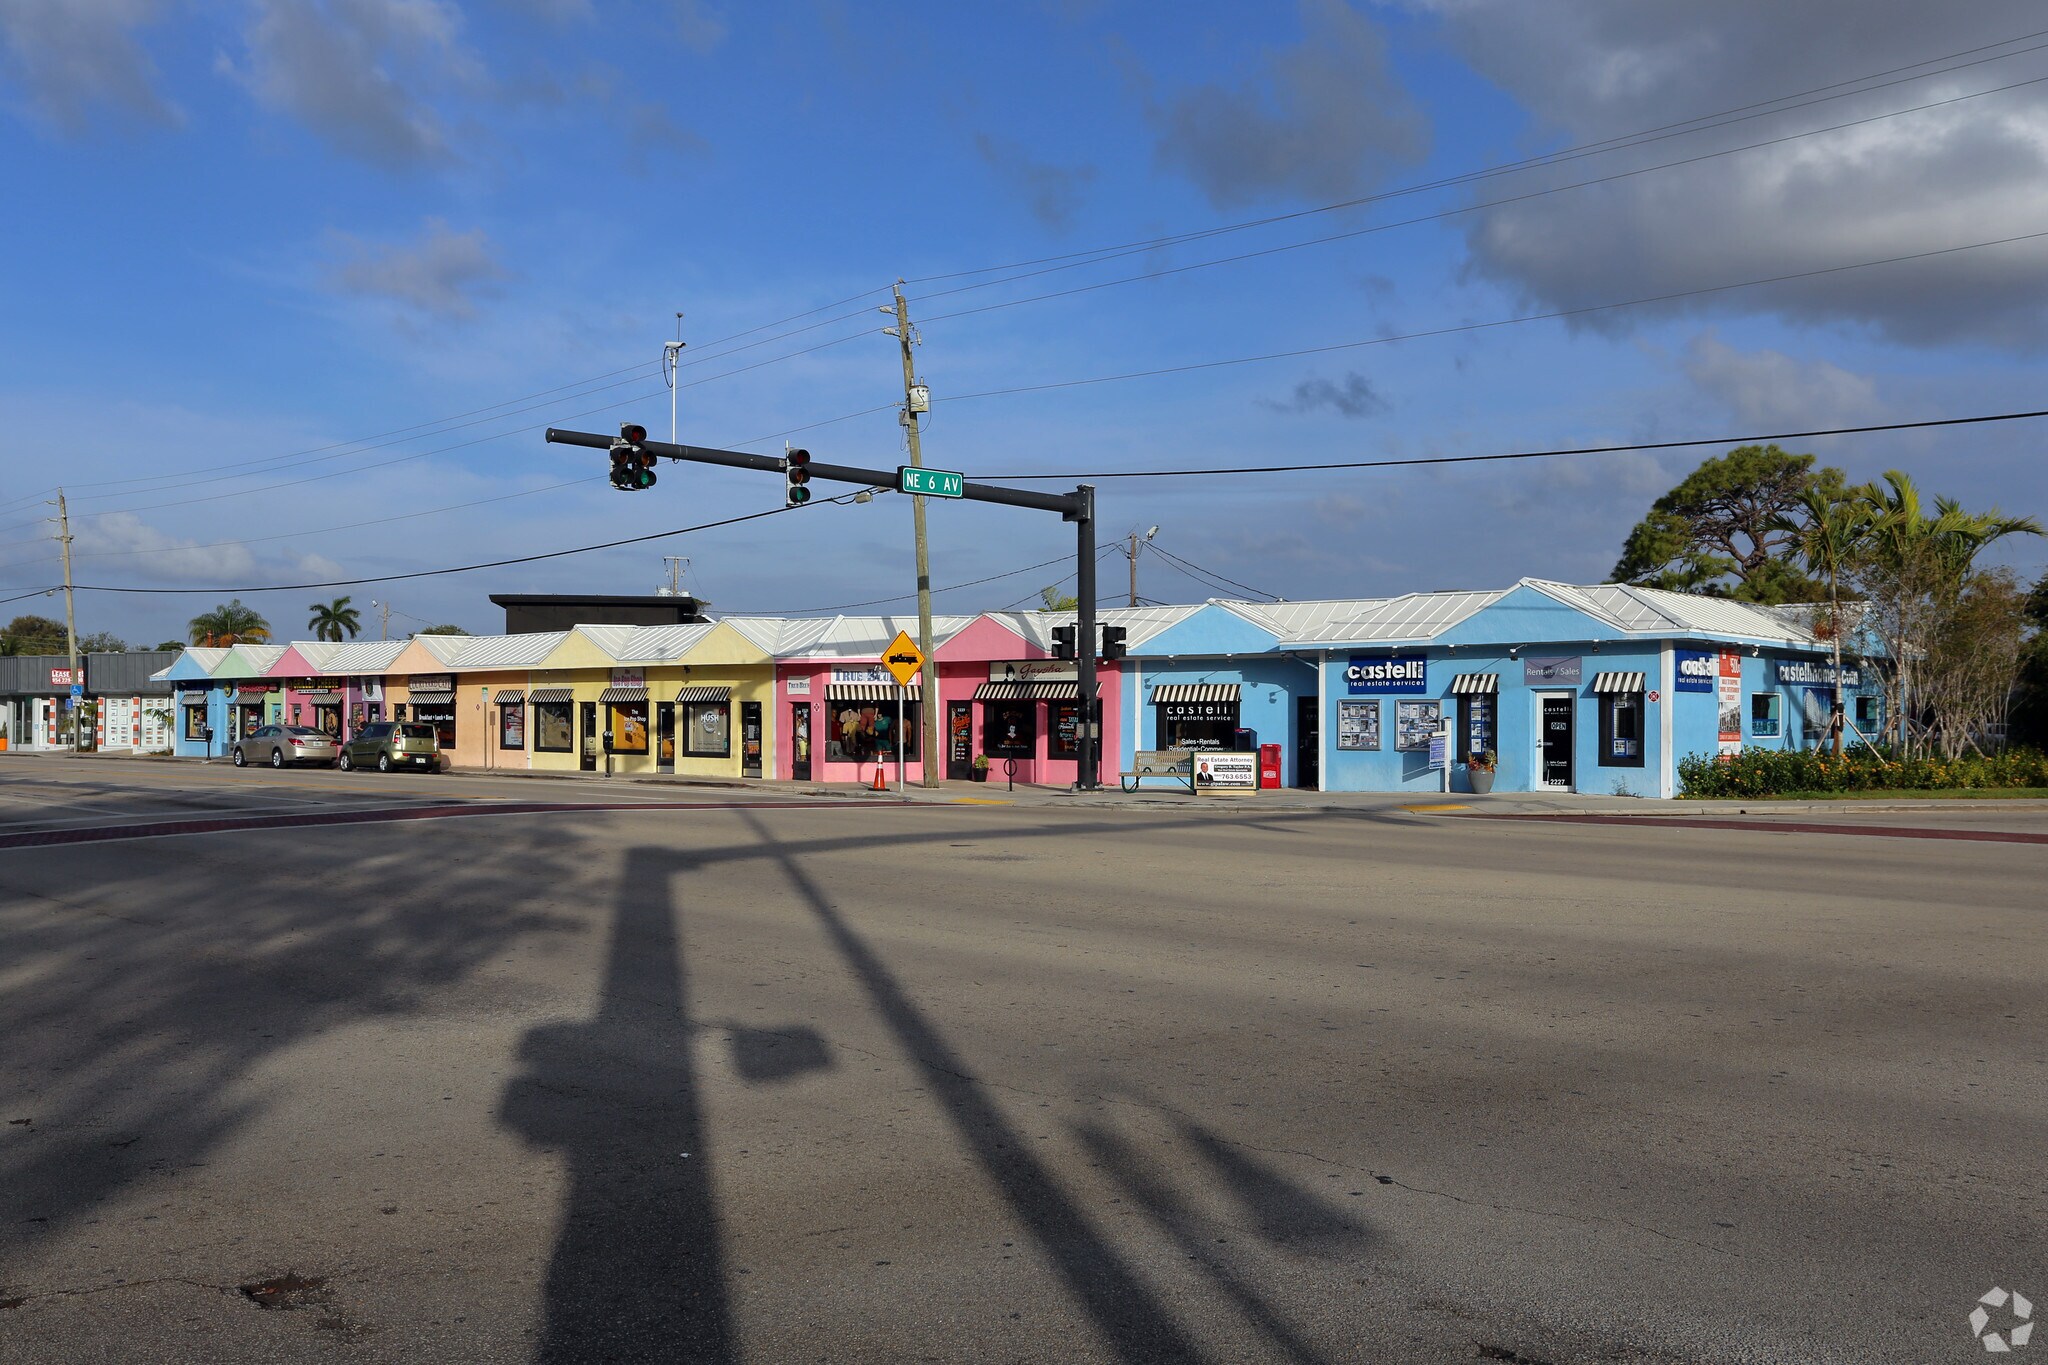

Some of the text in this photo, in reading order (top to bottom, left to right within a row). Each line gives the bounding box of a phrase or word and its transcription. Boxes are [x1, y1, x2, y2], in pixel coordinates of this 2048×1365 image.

[906, 473, 959, 492] NE 6 AV
[51, 669, 70, 678] LEASE
[1019, 663, 1066, 680] Gaysha
[1347, 661, 1424, 679] castelli
[1526, 668, 1554, 676] Rentals
[1560, 667, 1580, 676] Sales
[1166, 702, 1234, 715] castelli
[700, 714, 719, 722] HUSH
[1551, 722, 1567, 730] OPEN
